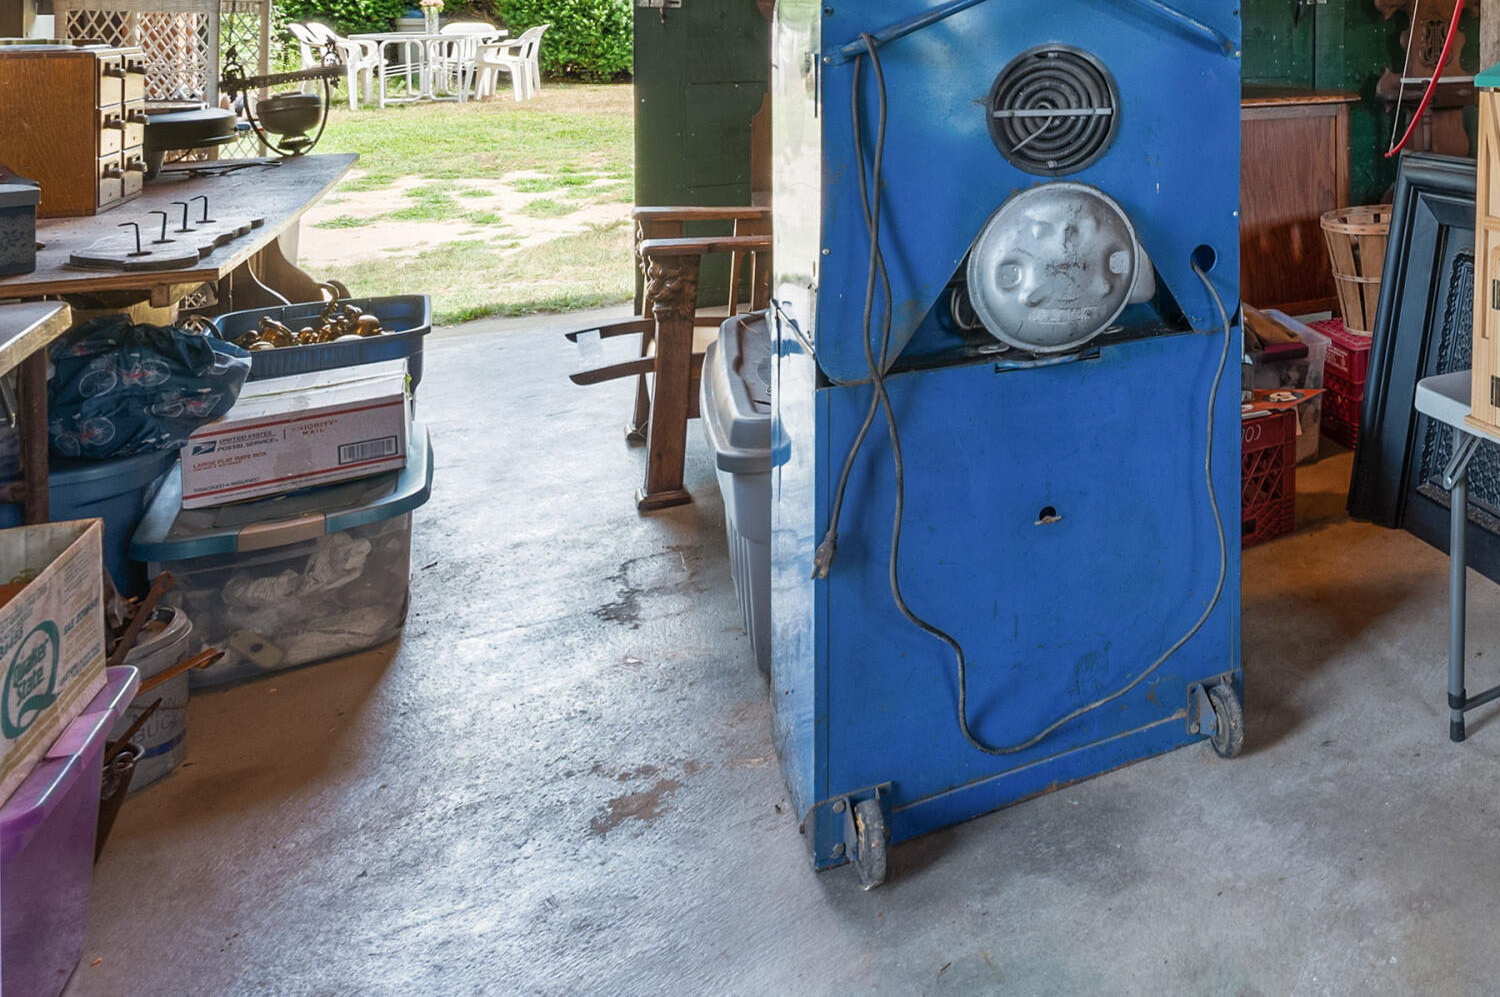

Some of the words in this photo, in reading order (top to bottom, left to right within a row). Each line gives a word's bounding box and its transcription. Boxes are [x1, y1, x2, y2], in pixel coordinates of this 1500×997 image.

[219, 434, 247, 443] UNITED
[247, 430, 273, 439] STATES
[217, 442, 245, 452] POSTAL
[192, 460, 217, 470] LARGE
[217, 456, 234, 464] FLAT
